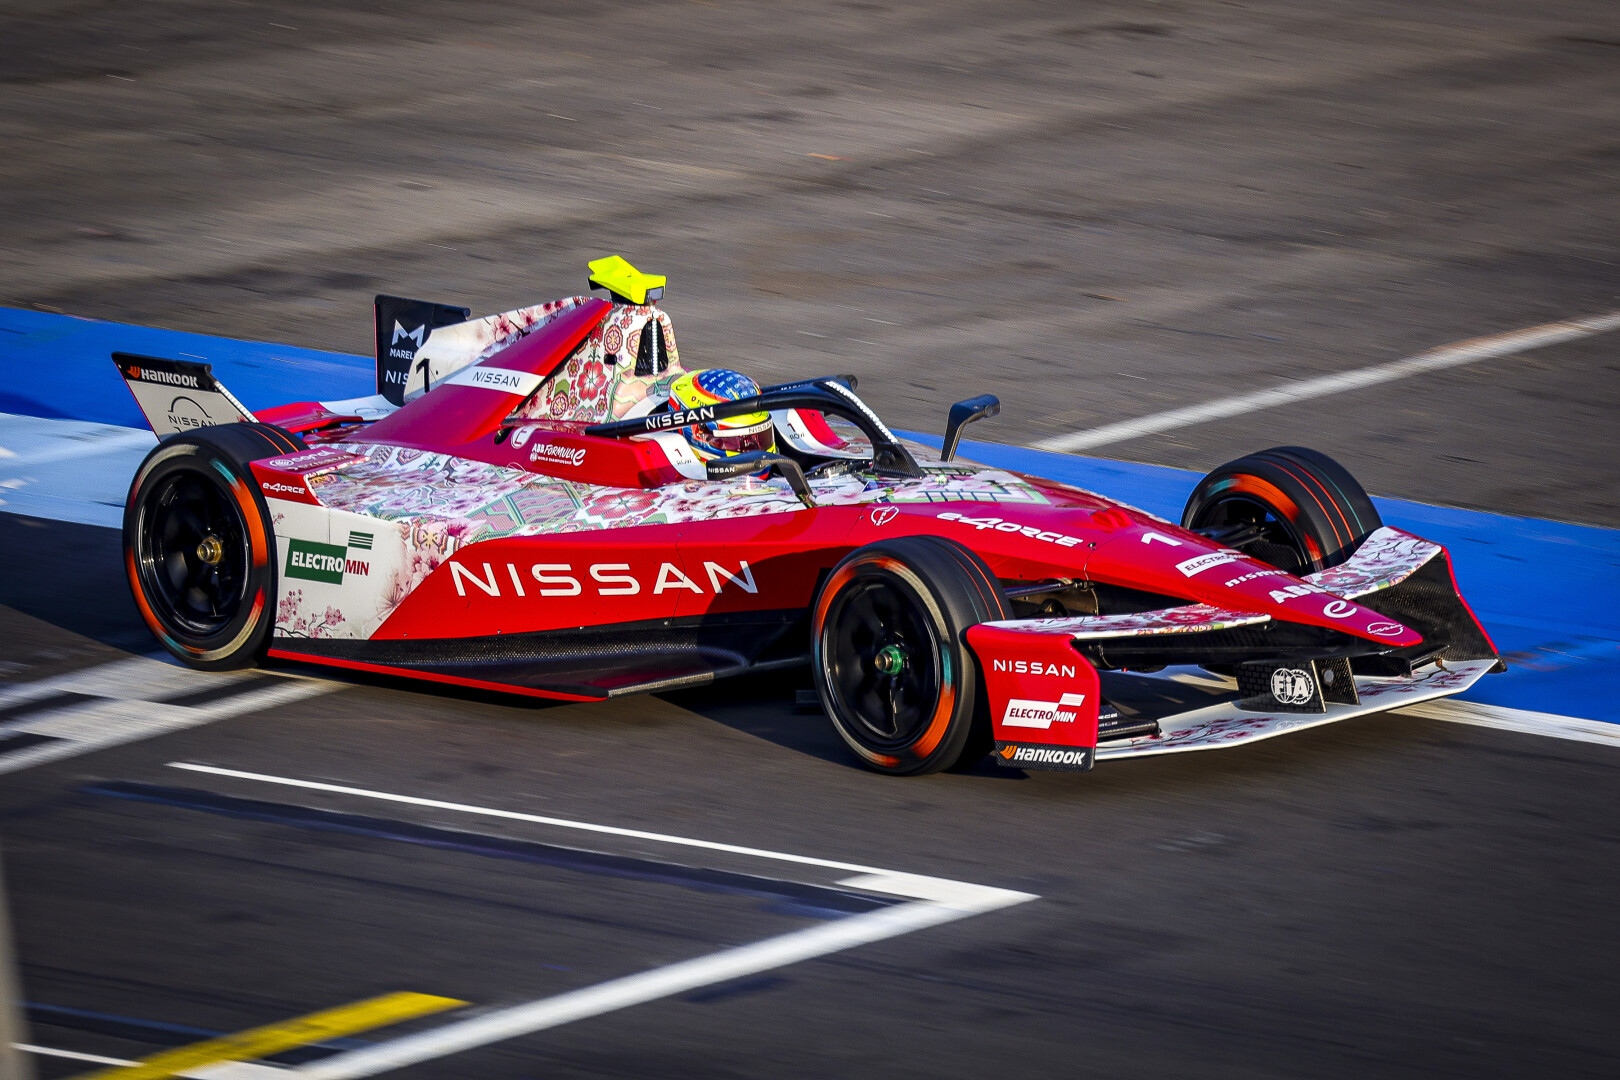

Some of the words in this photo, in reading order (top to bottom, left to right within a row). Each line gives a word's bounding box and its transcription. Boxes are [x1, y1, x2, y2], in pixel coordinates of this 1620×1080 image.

[389, 347, 415, 360] MAREL
[385, 369, 409, 385] NIS
[415, 358, 431, 393] 1
[472, 371, 521, 388] NISSAN
[645, 407, 715, 430] NISSAN
[786, 422, 796, 432] 1
[544, 444, 576, 460] FORMULA
[674, 448, 683, 457] 1
[1140, 531, 1183, 547] 1
[291, 551, 370, 576] ELECTROMIN
[449, 560, 759, 598] NISSAN
[993, 659, 1075, 678] NISSAN
[1009, 707, 1078, 723] ELECTROMIN
